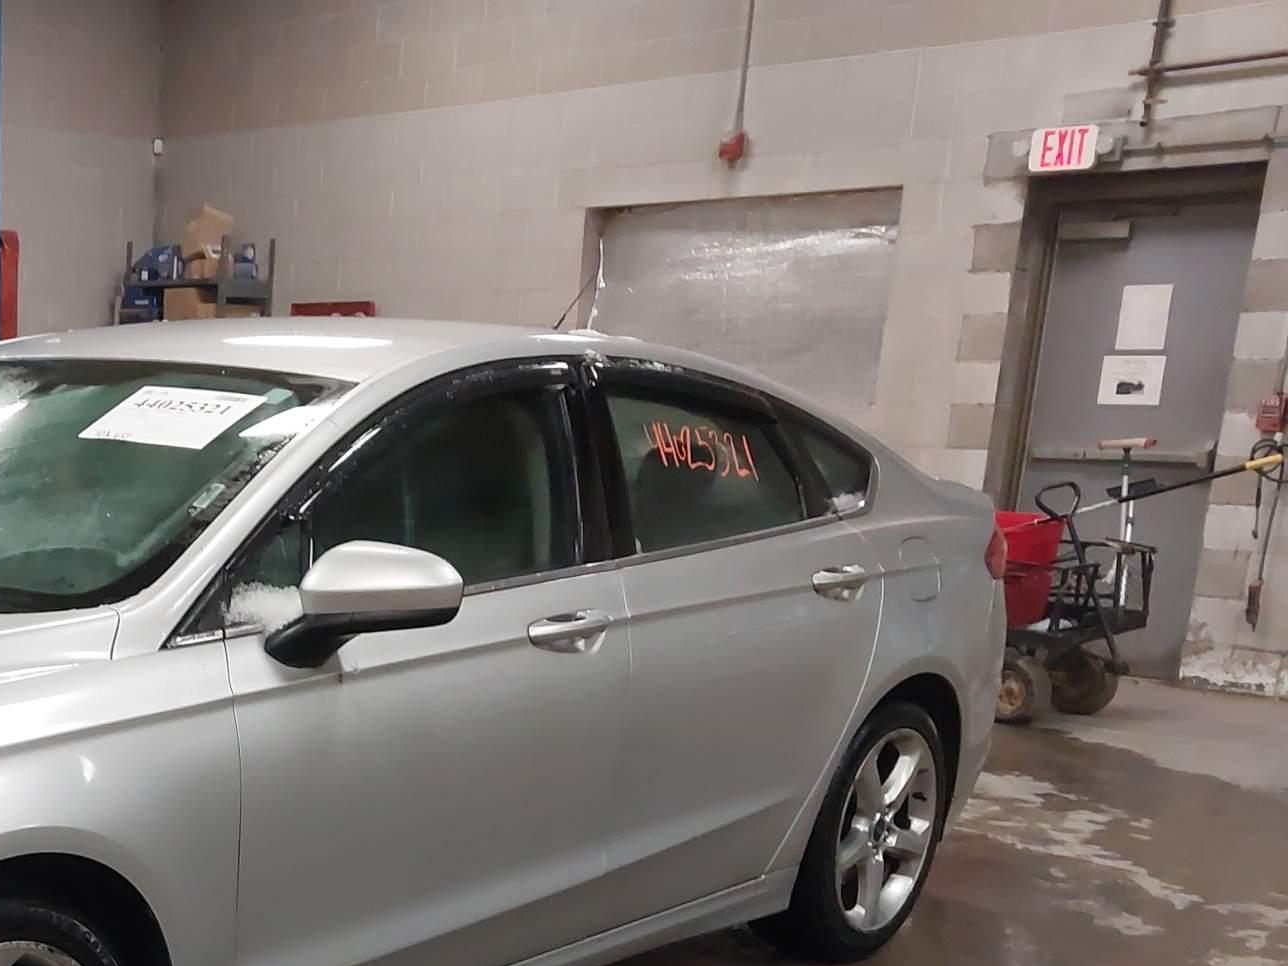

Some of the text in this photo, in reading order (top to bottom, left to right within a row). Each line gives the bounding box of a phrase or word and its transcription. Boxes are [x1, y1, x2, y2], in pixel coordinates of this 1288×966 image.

[1039, 128, 1089, 168] EXIT
[133, 397, 232, 416] 44025321
[642, 420, 760, 484] 44025321
